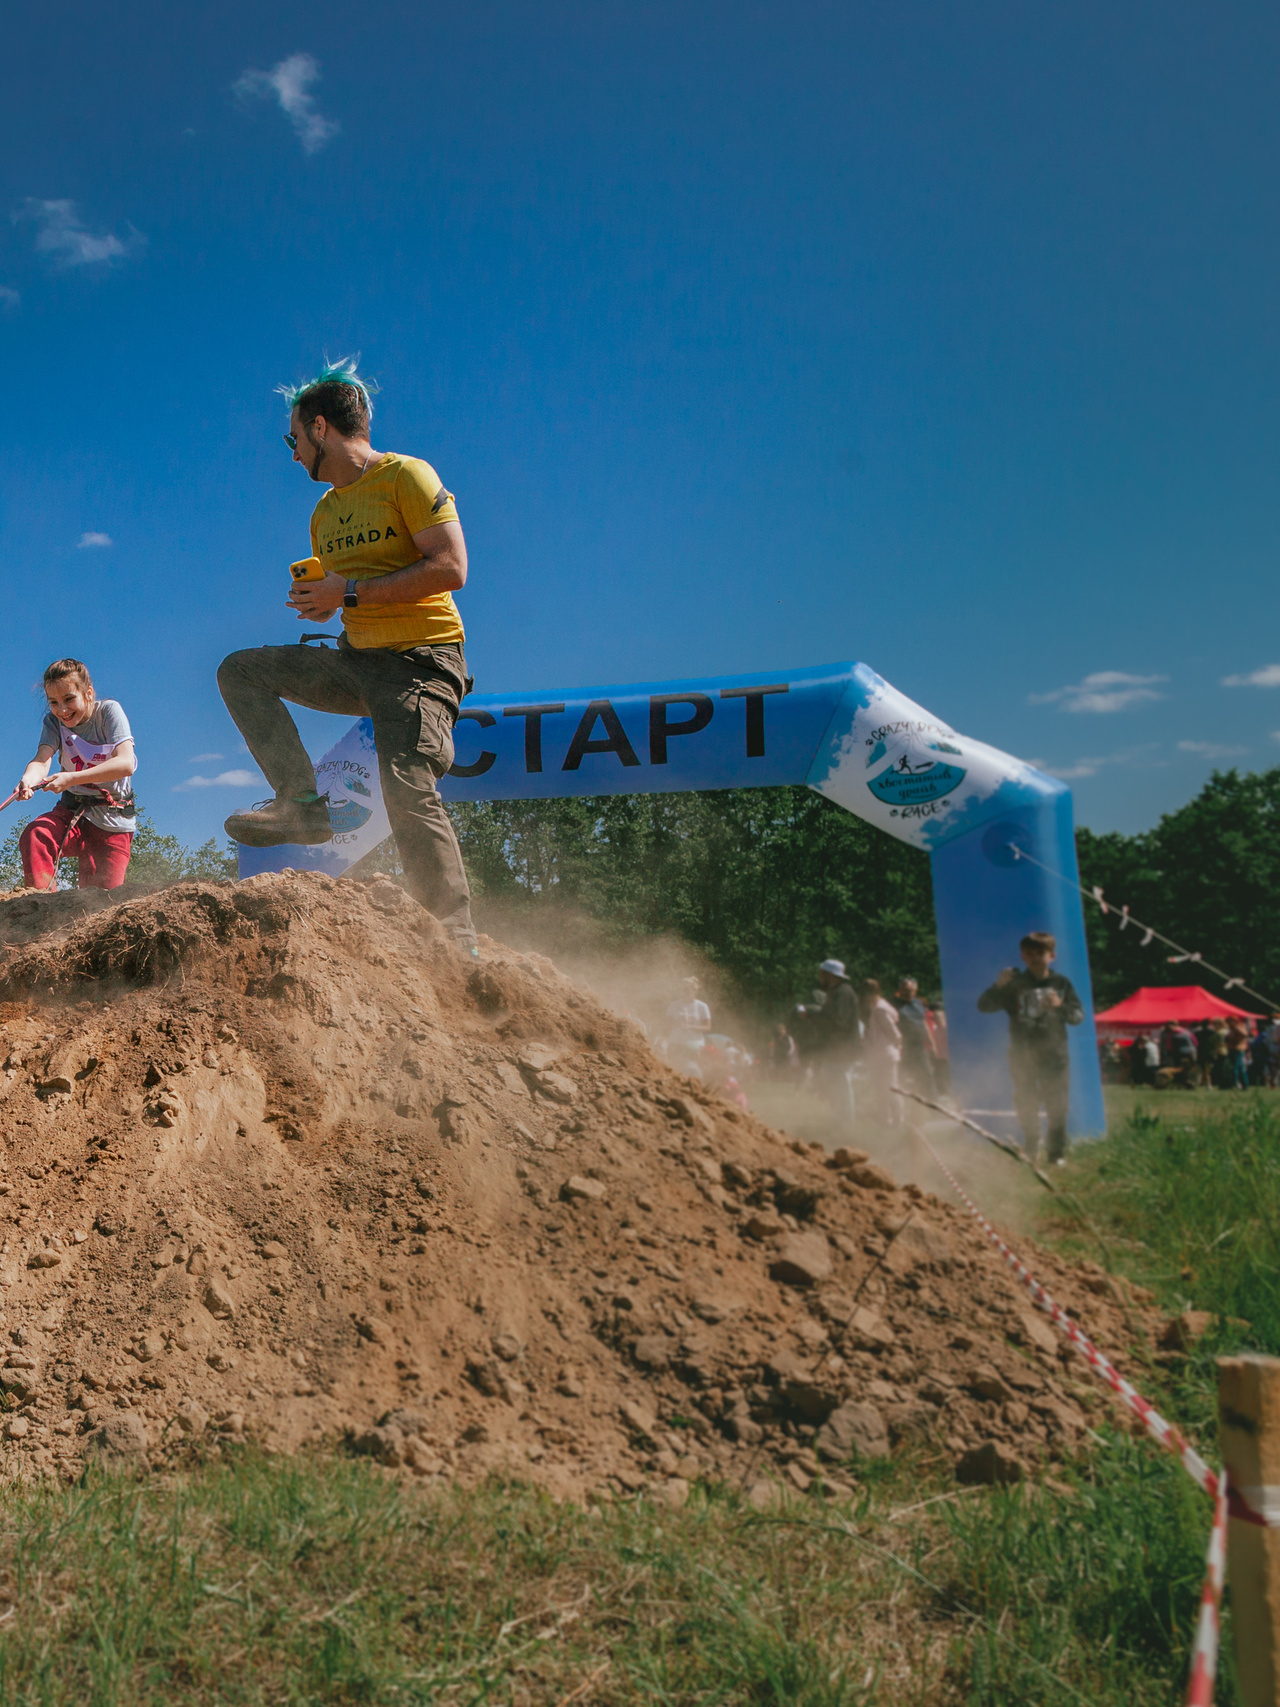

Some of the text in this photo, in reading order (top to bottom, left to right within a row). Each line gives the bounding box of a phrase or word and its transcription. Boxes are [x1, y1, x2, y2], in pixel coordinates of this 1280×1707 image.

[871, 721, 909, 741] CRAZY
[314, 760, 367, 777] RAZY DOG
[901, 802, 941, 819] RACE
[331, 833, 351, 845] CE
